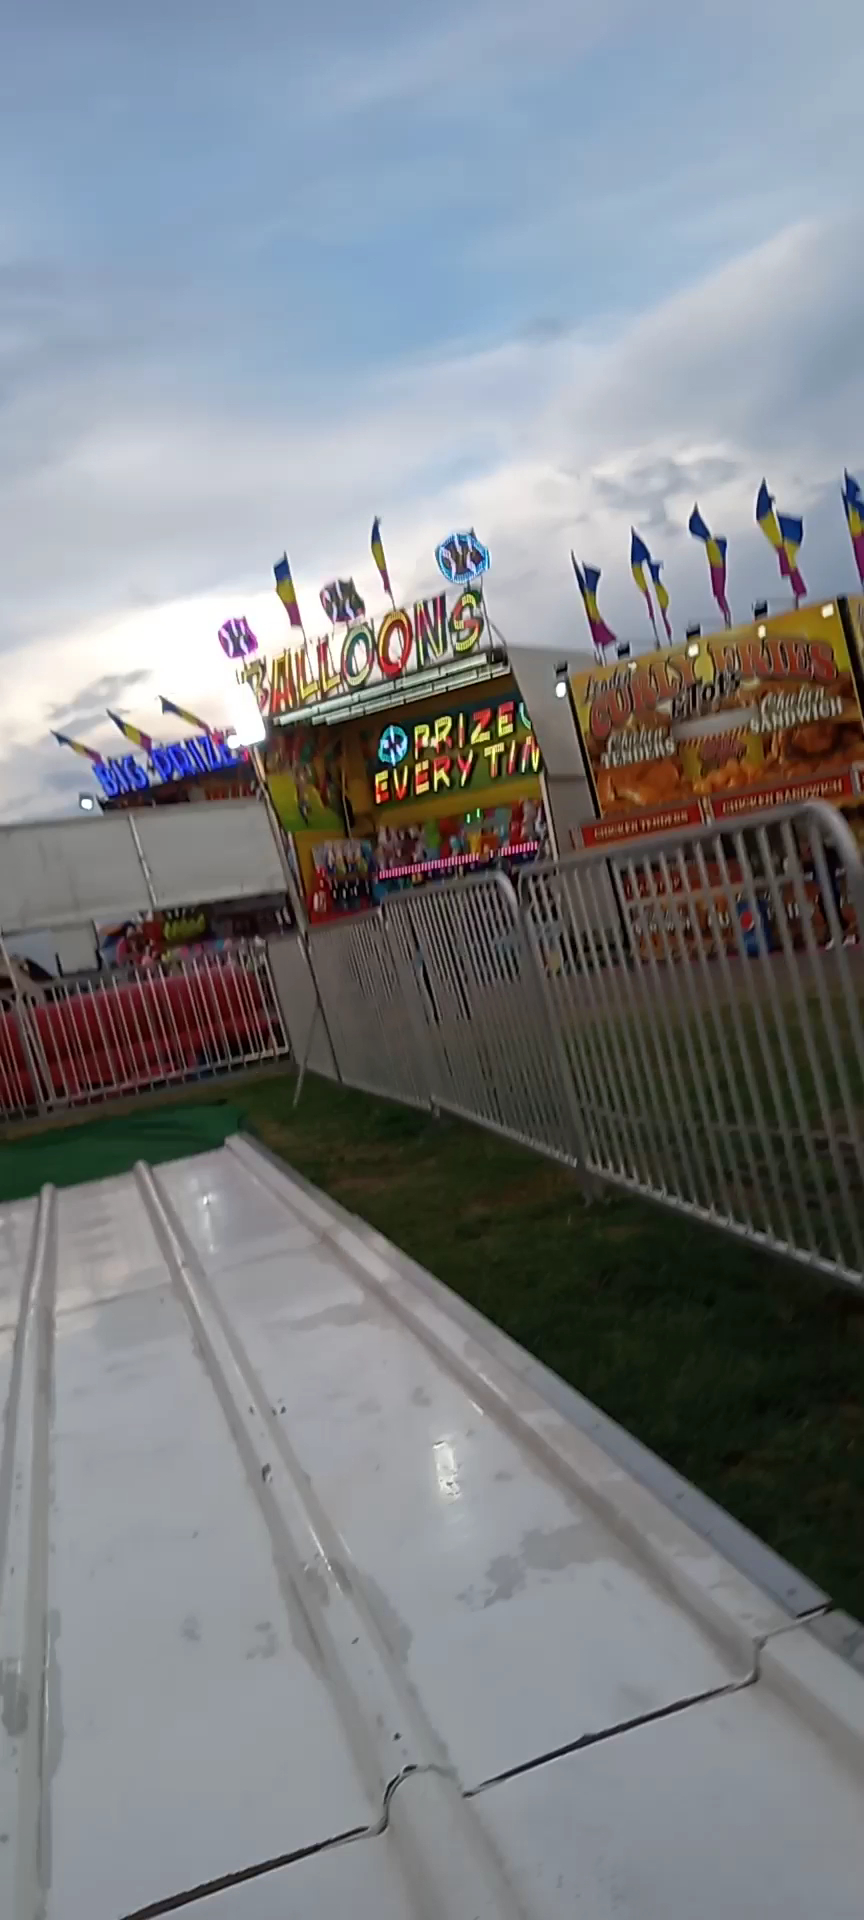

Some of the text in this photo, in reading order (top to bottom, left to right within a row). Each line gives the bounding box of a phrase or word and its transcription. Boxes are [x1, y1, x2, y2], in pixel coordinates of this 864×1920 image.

[245, 588, 485, 716] BALLOONS
[590, 652, 696, 738] CURLY
[750, 695, 843, 734] SANDWICH
[91, 754, 149, 797] BIG
[152, 735, 244, 784] PRIZE
[375, 749, 473, 804] EVERY
